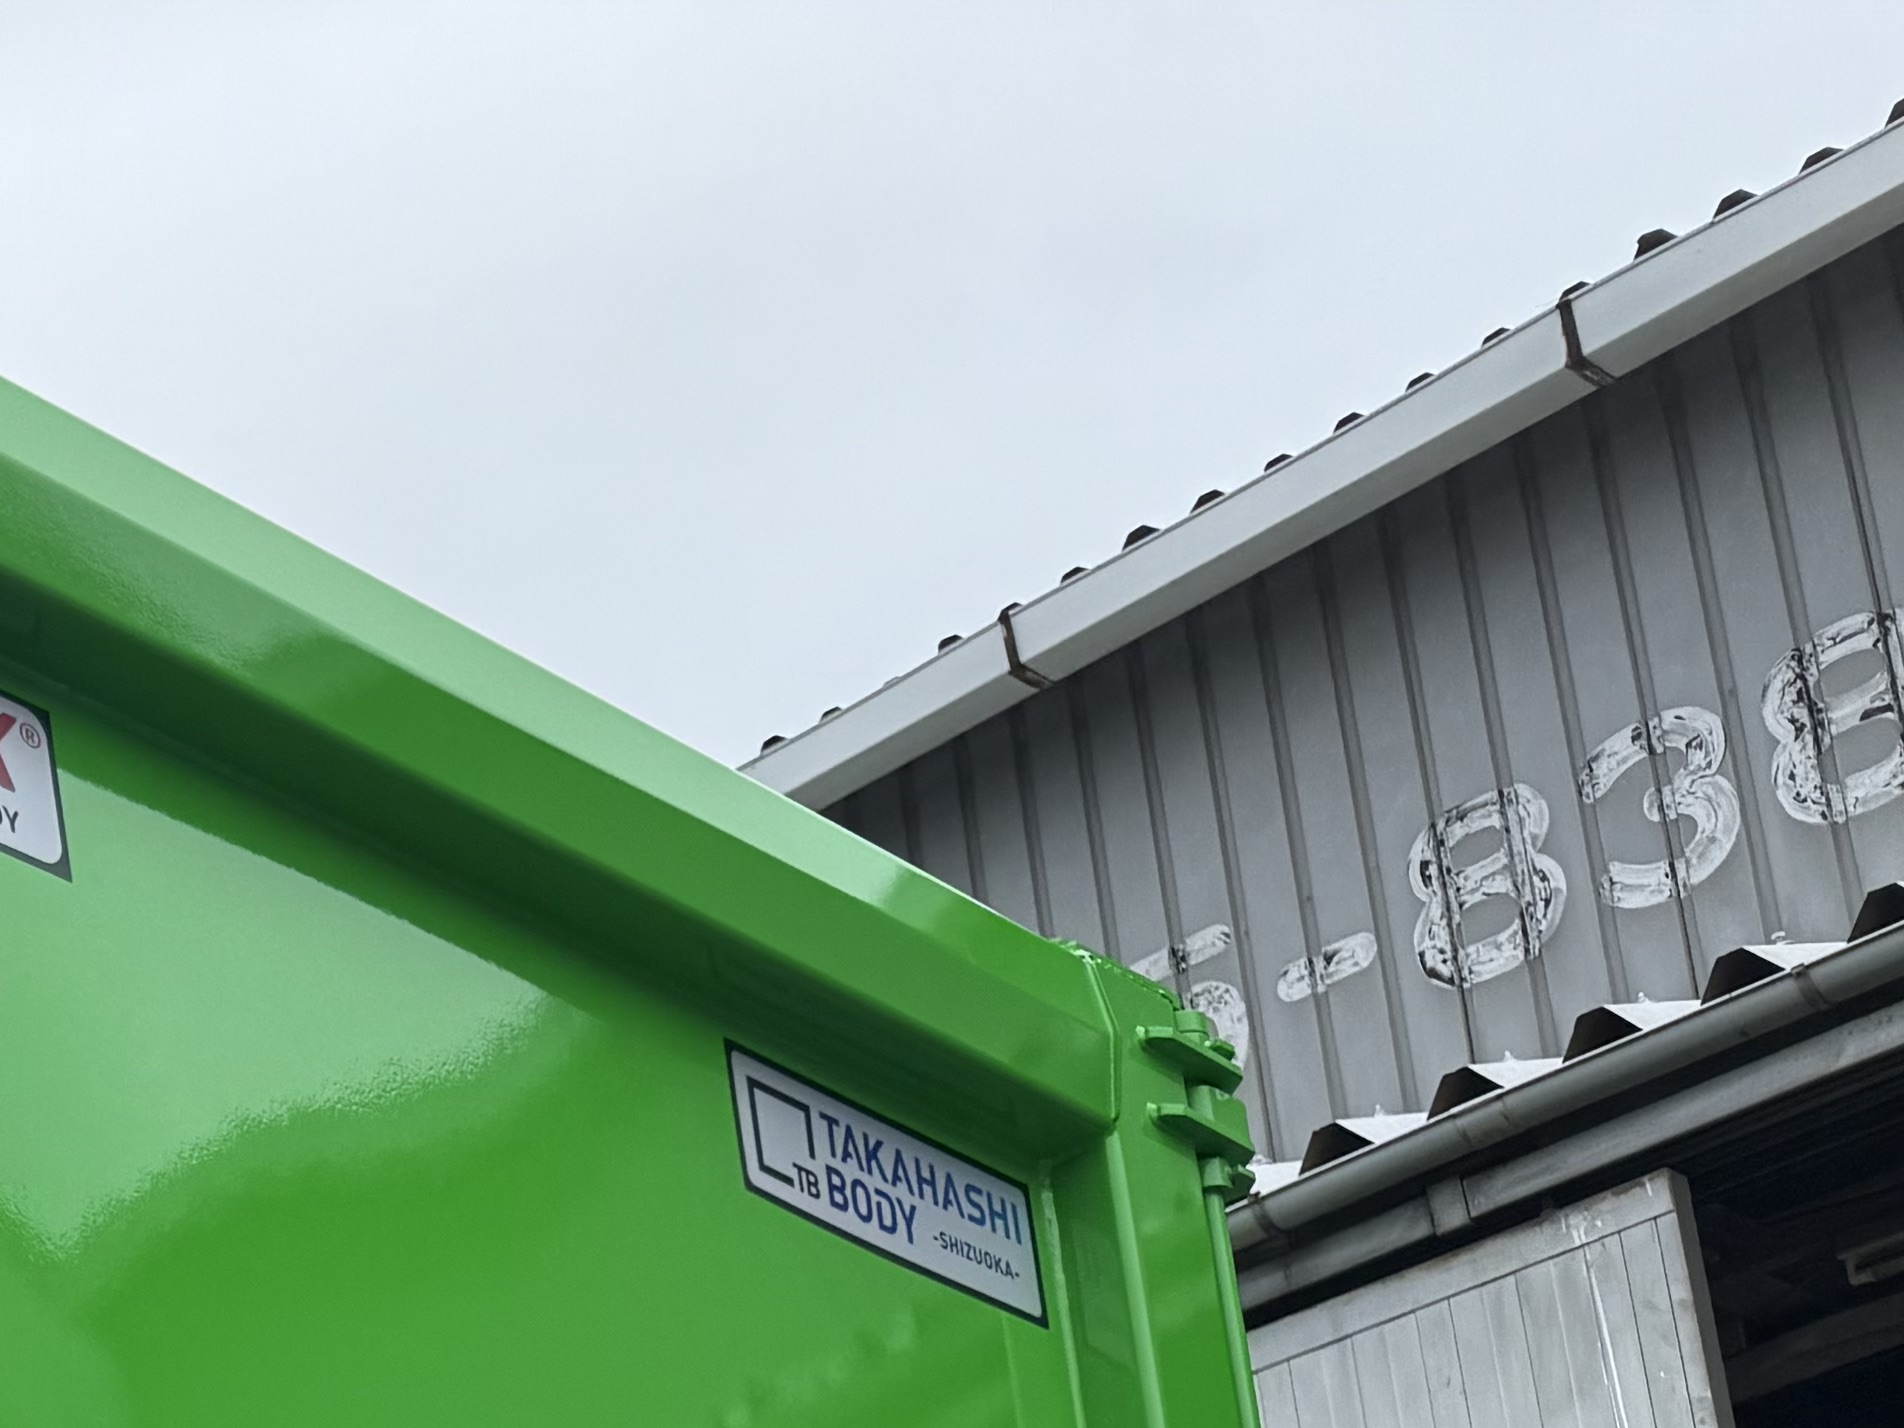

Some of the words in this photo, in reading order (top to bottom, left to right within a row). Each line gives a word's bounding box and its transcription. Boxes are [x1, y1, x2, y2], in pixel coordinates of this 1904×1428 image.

[793, 1162, 821, 1200] TB
[819, 1111, 1023, 1246] TAKAHASHI
[824, 1164, 917, 1245] BODY
